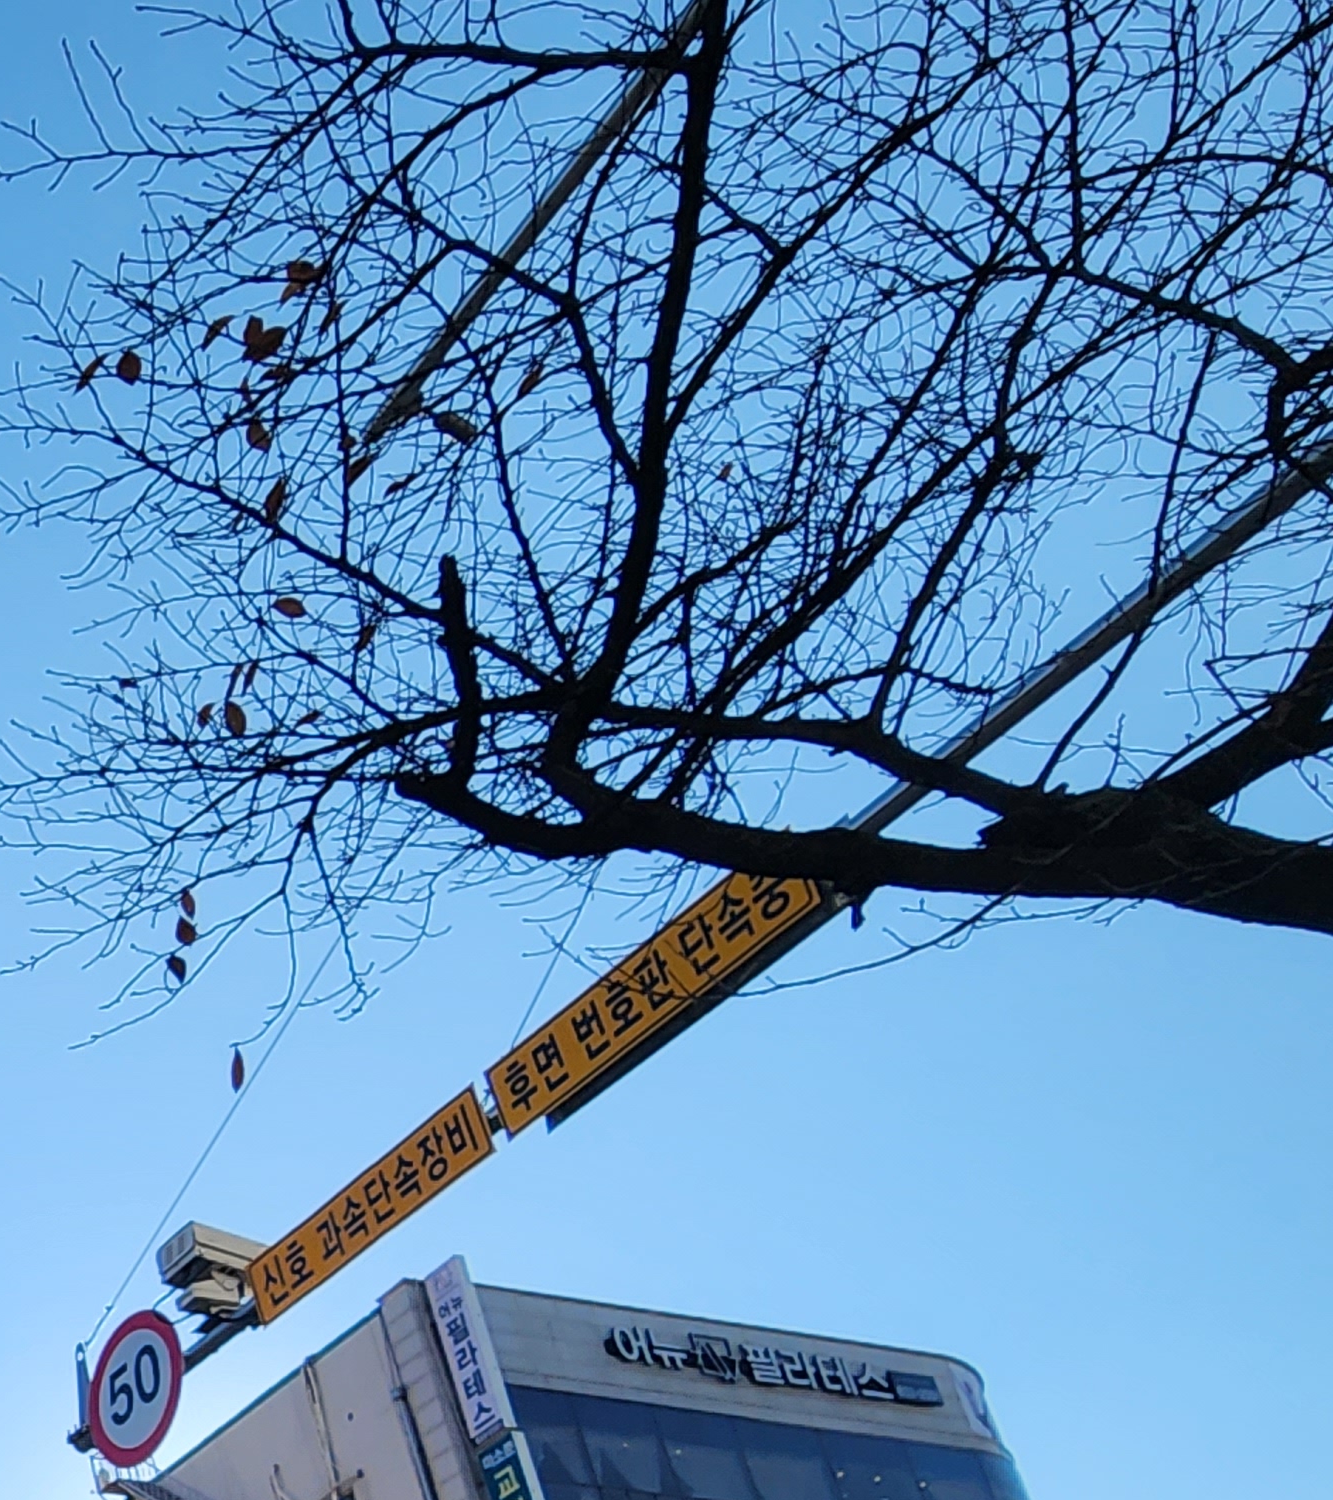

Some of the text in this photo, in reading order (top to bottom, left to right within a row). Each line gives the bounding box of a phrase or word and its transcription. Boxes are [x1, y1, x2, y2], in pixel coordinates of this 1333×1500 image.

[504, 875, 790, 1112] 후면 번호판 단속중
[264, 1104, 478, 1306] 신호 과속단속장비
[108, 1343, 161, 1427] 50
[445, 1313, 496, 1431] 필라테스
[745, 1347, 895, 1399] 필라테스
